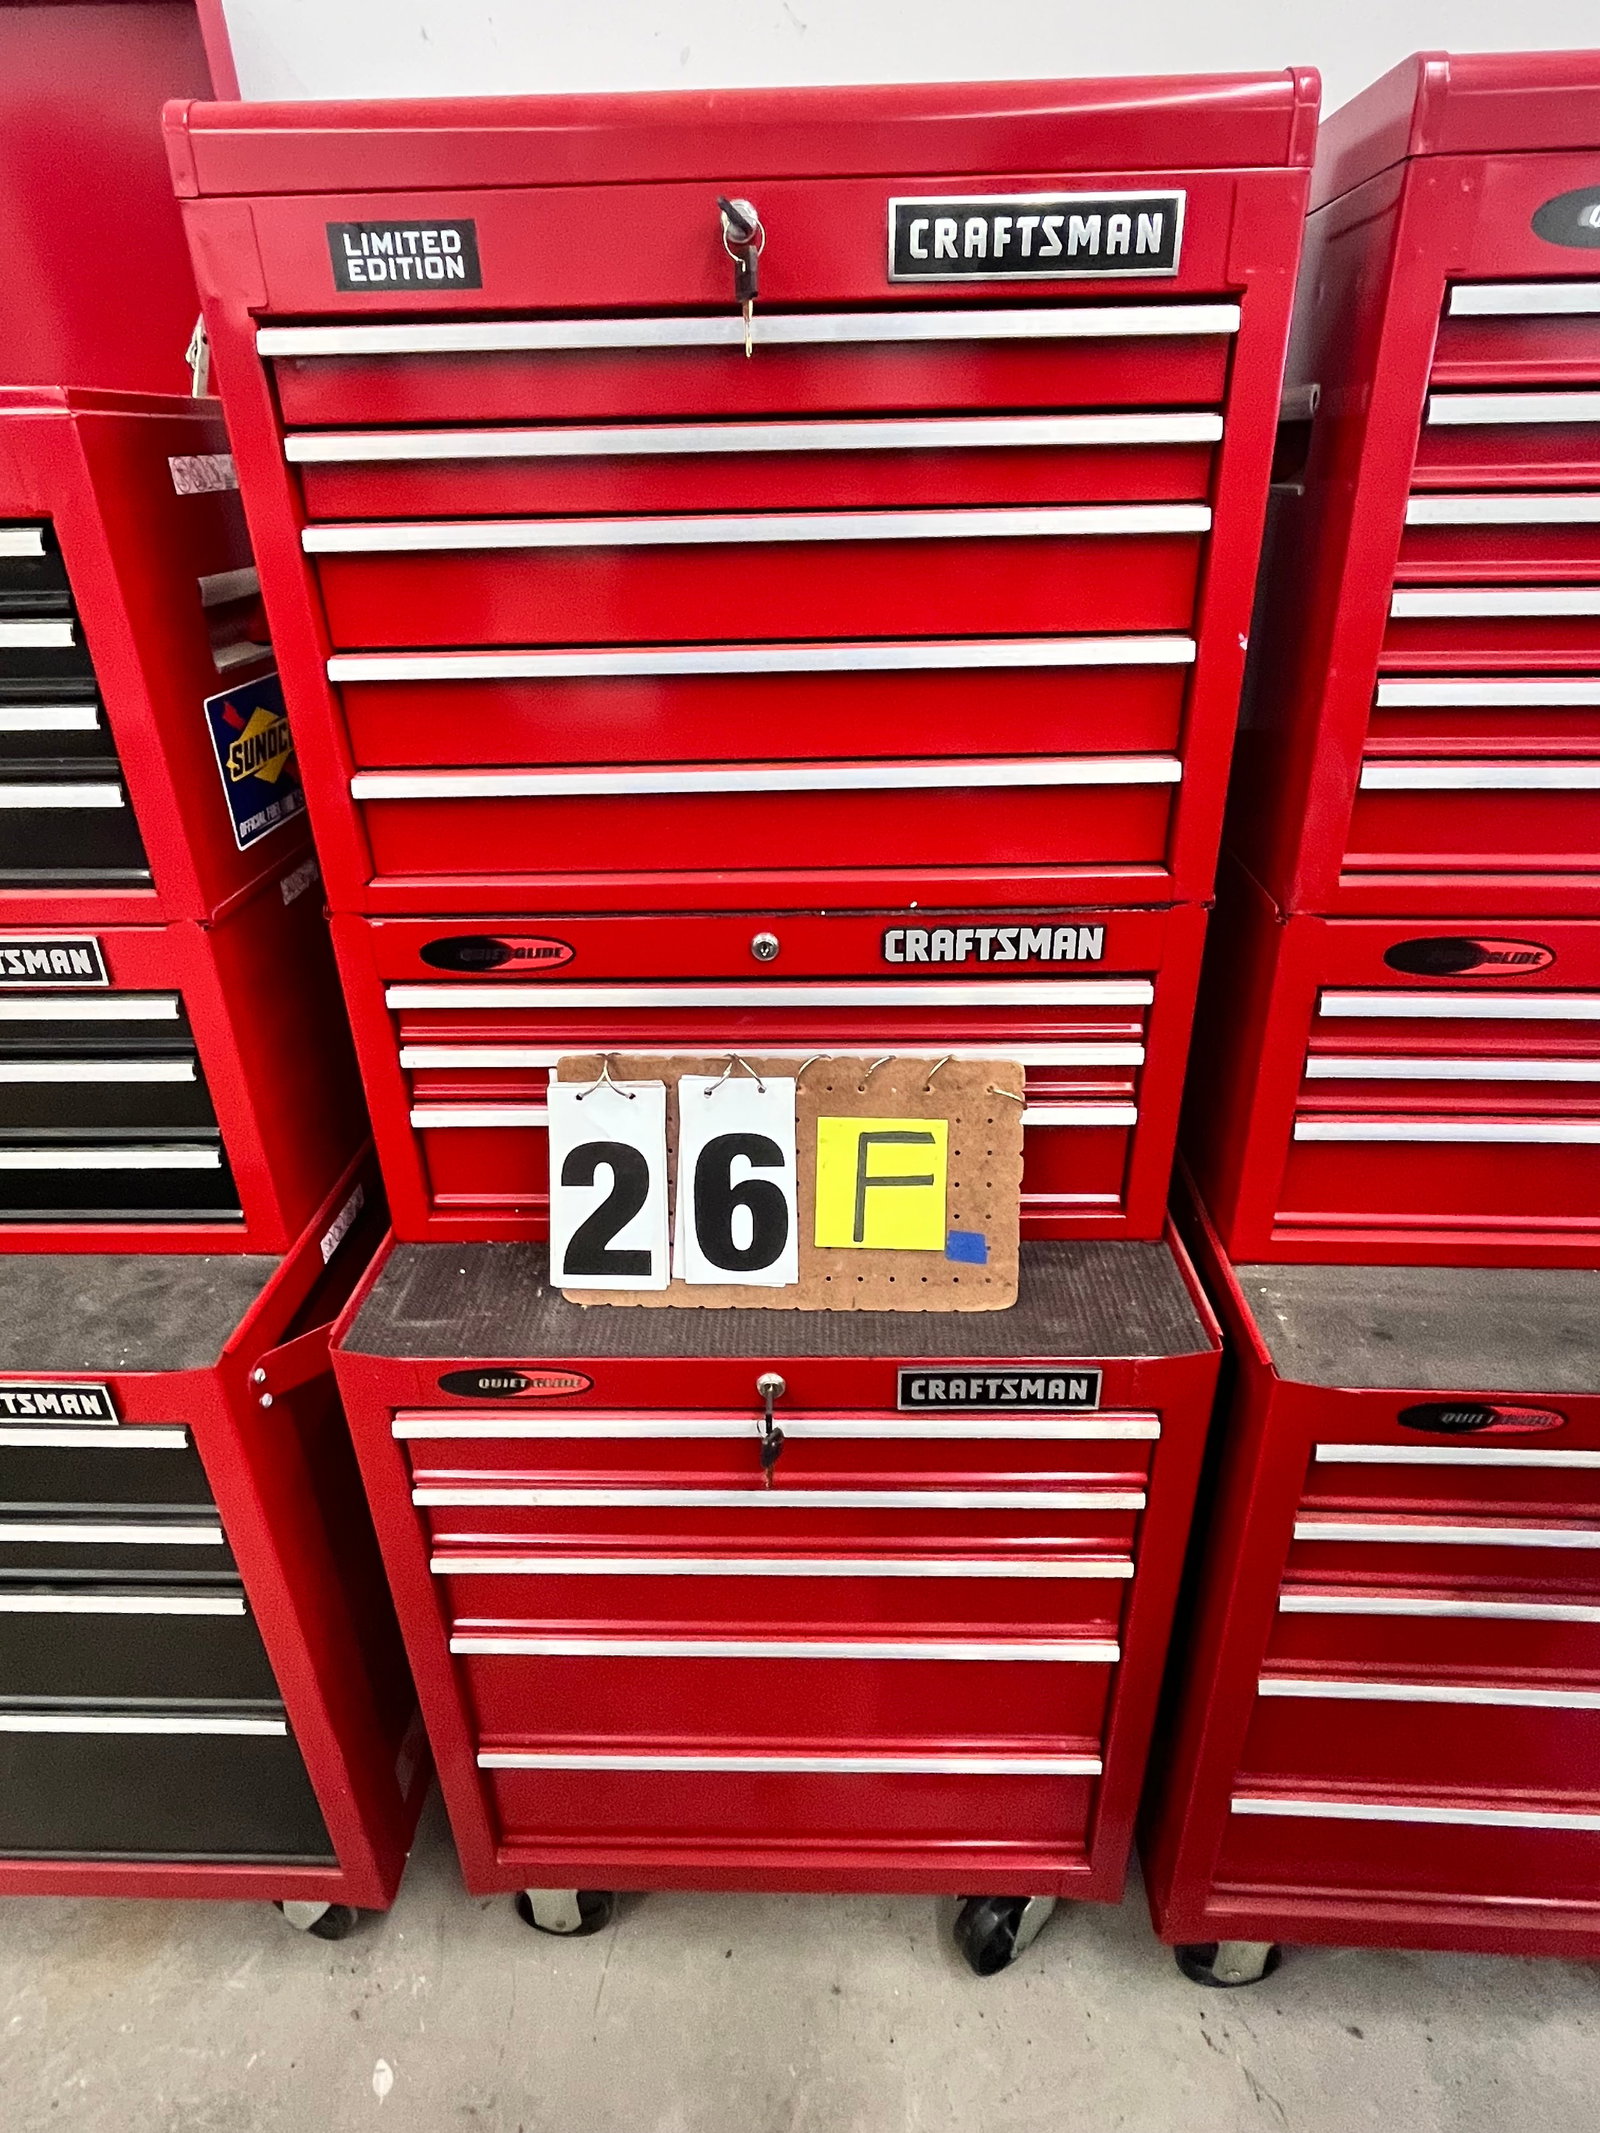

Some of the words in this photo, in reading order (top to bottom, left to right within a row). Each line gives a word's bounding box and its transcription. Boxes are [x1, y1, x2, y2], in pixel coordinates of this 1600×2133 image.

[343, 229, 461, 256] LIMITED
[909, 212, 1163, 259] CRAFTSMAN
[347, 255, 465, 281] EDITION
[232, 720, 292, 777] SUNOC
[885, 927, 1104, 962] CRAFTSMAN
[853, 1131, 935, 1243] F
[478, 1377, 528, 1389] QUIET
[911, 1378, 1089, 1400] CRAFTSMAN
